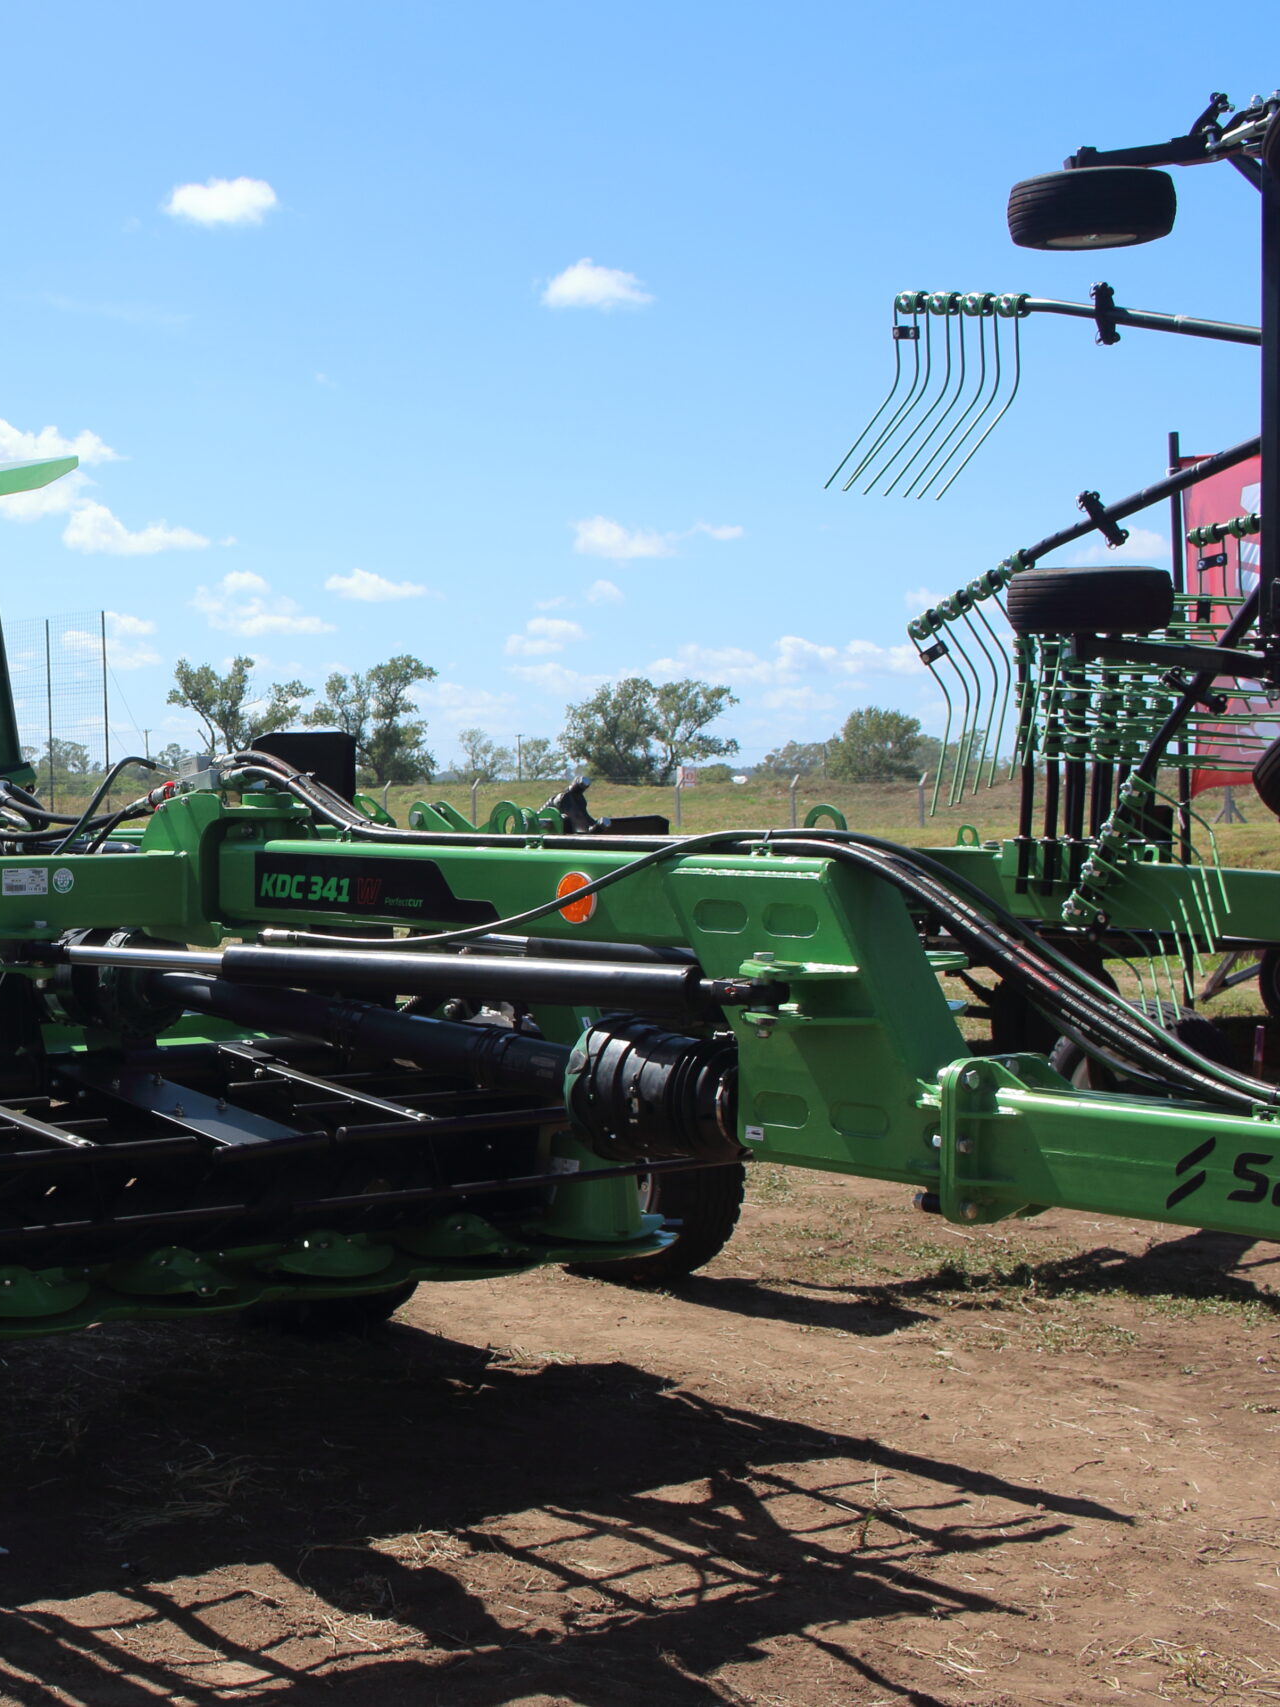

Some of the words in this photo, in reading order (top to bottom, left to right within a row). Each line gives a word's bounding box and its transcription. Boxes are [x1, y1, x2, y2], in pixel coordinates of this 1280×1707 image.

[260, 873, 306, 900] KDC
[307, 876, 350, 903] 341
[1227, 1152, 1280, 1208] S
